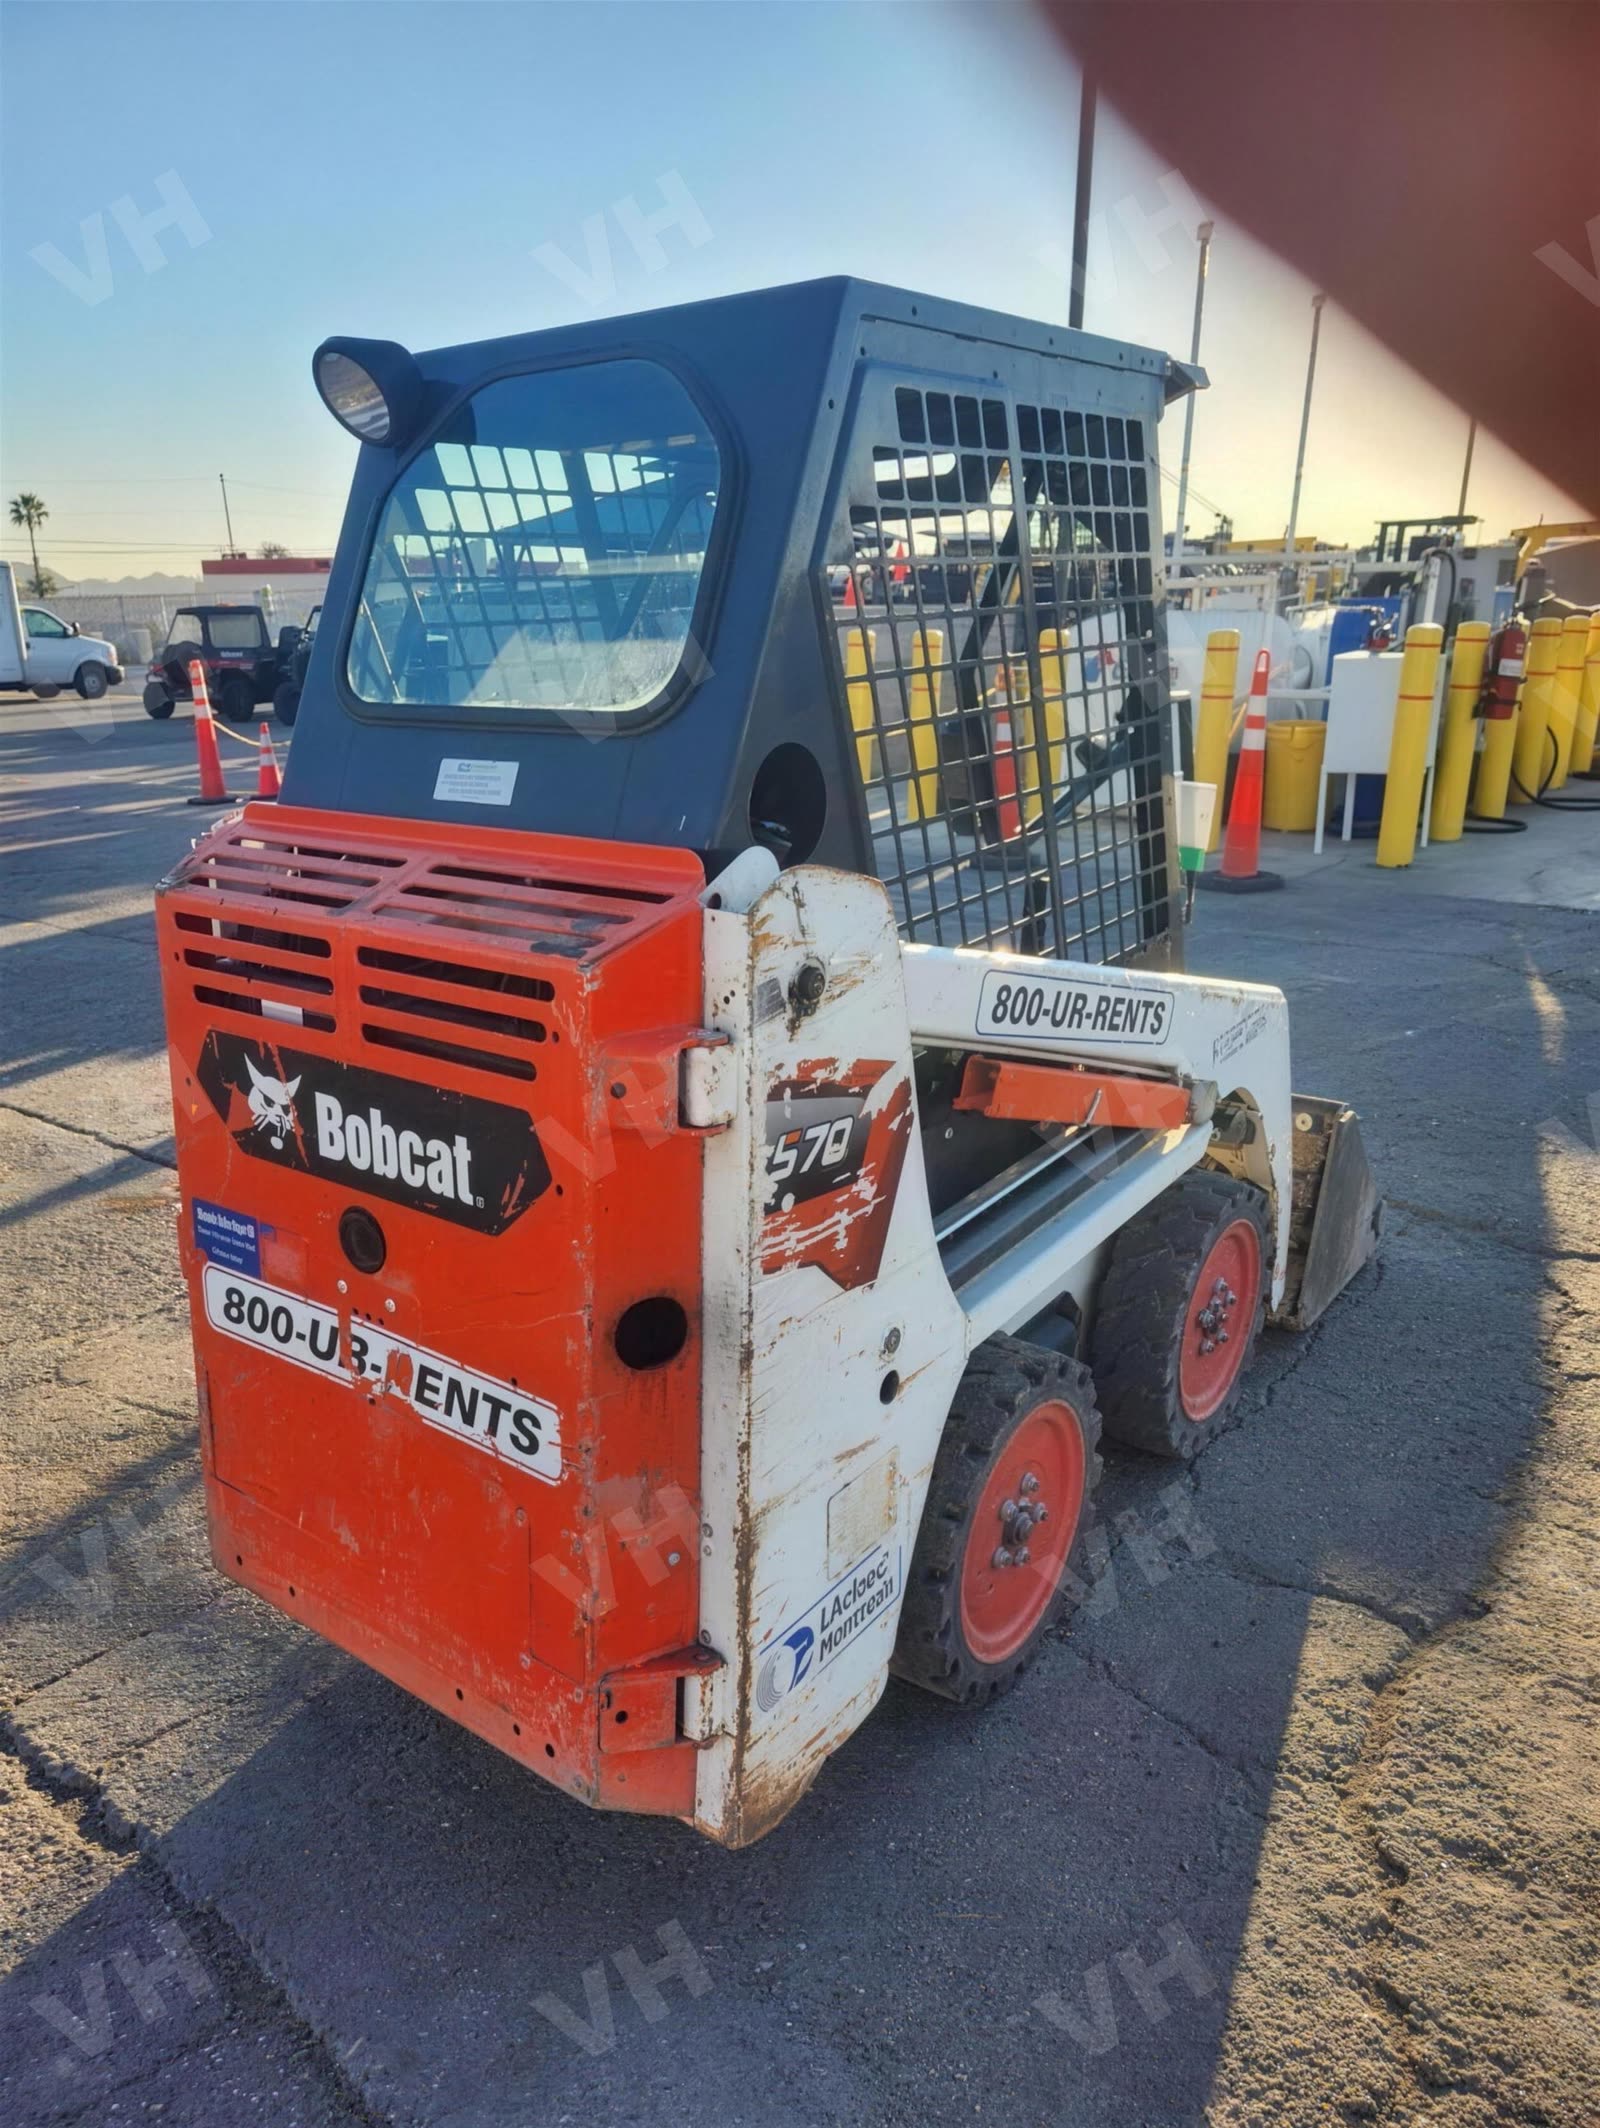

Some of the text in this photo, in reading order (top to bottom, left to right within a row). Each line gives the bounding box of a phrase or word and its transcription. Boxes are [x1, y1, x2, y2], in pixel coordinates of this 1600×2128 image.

[991, 984, 1166, 1036] 800-UR-RENTS
[314, 1091, 474, 1206] Bobcat
[222, 1286, 543, 1457] 800-UR-ENTS
